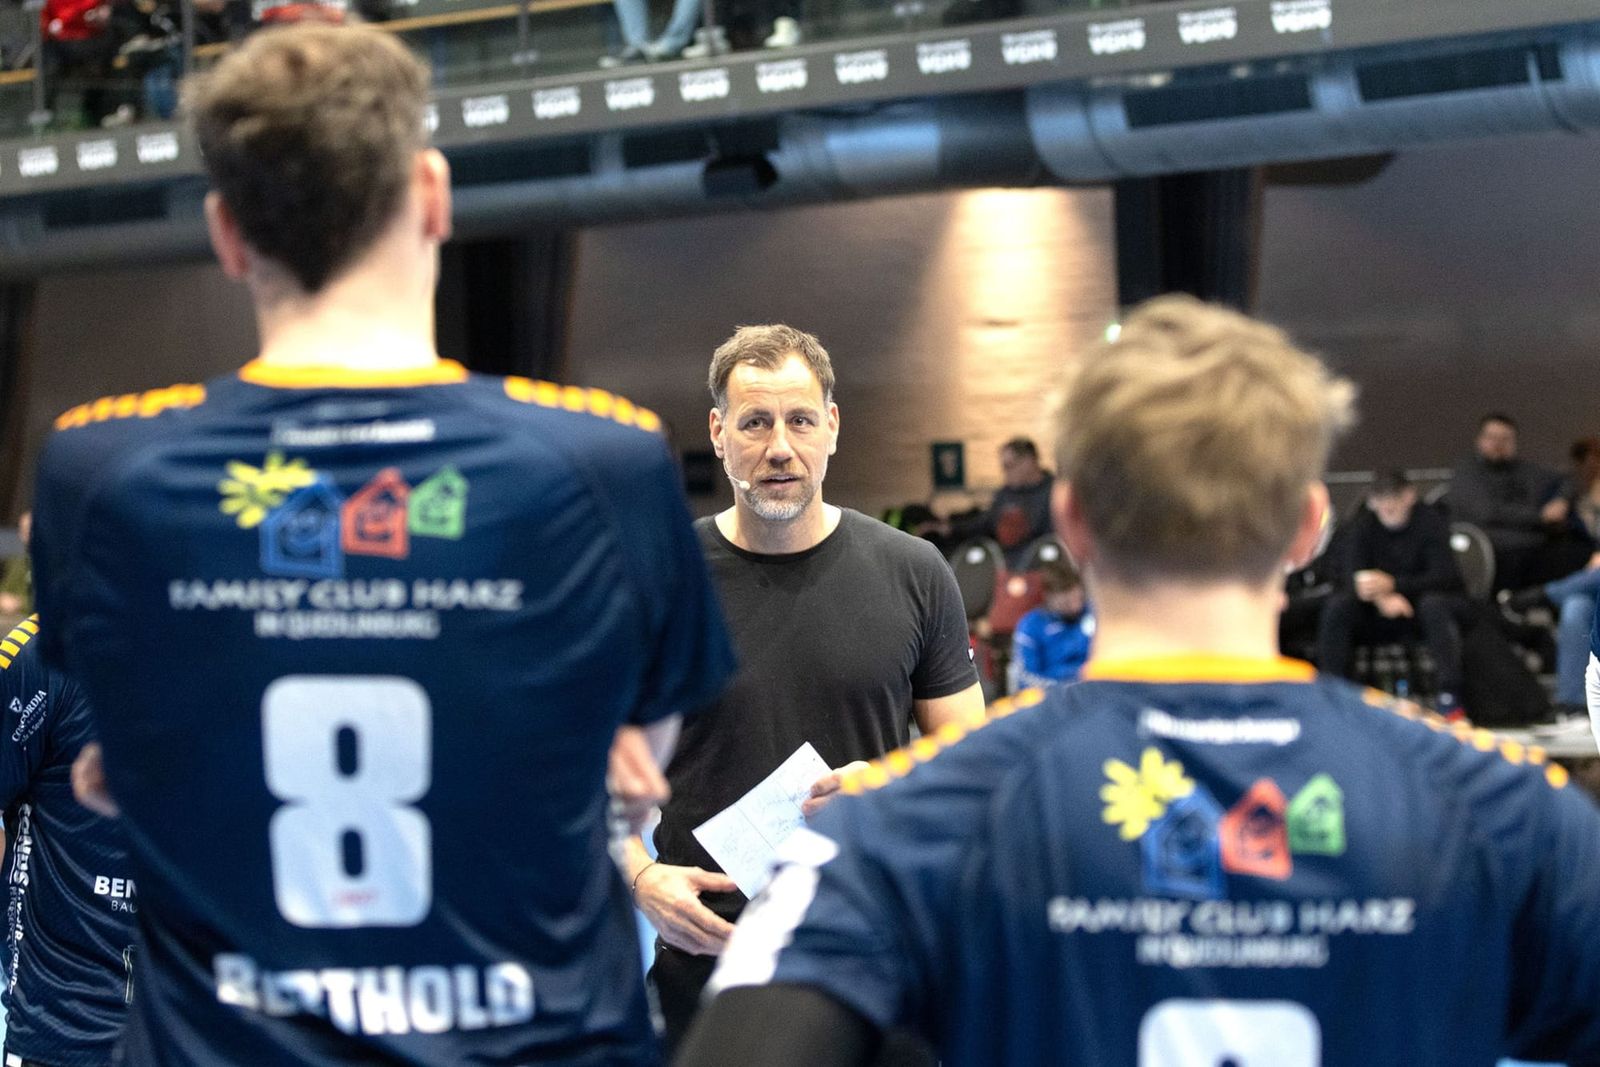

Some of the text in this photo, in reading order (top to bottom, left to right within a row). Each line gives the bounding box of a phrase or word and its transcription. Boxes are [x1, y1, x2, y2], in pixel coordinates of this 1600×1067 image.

[168, 578, 523, 611] FAMILY CLUB HARZ
[261, 674, 432, 928] 8
[1190, 900, 1294, 935] CLUB
[1298, 897, 1415, 934] HARZ
